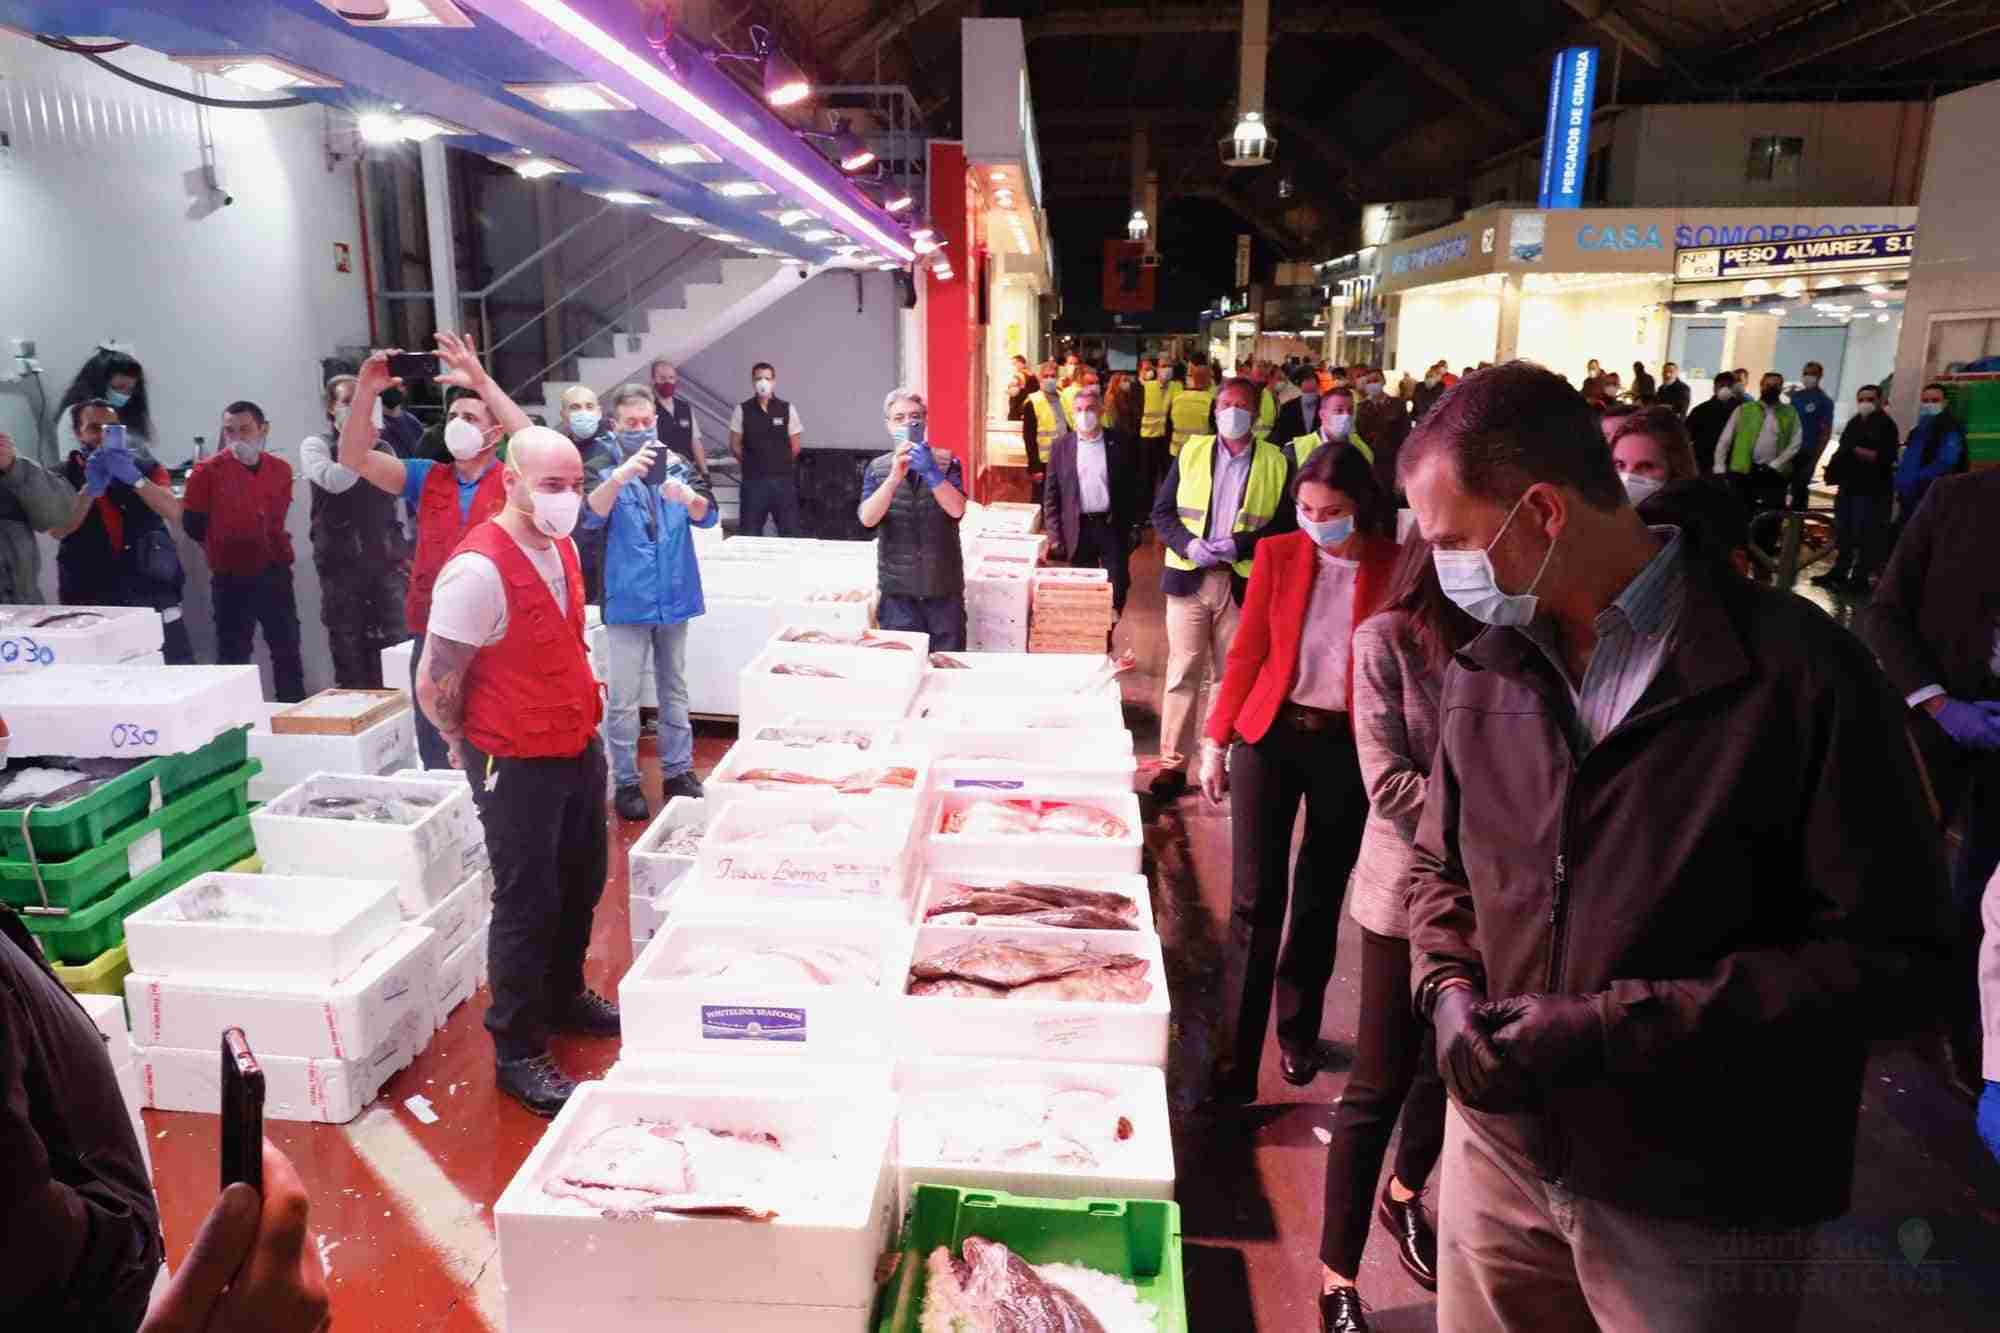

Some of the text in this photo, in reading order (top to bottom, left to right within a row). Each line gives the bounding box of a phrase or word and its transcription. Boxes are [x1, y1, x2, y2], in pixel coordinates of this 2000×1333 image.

[1571, 50, 1590, 107] CRIANZA
[1569, 107, 1583, 126] DE
[1576, 223, 1914, 251] CASA SOMORRO
[1724, 246, 1777, 264] PESO
[1783, 239, 1876, 260] ALVAREZ,
[111, 723, 158, 748] 030
